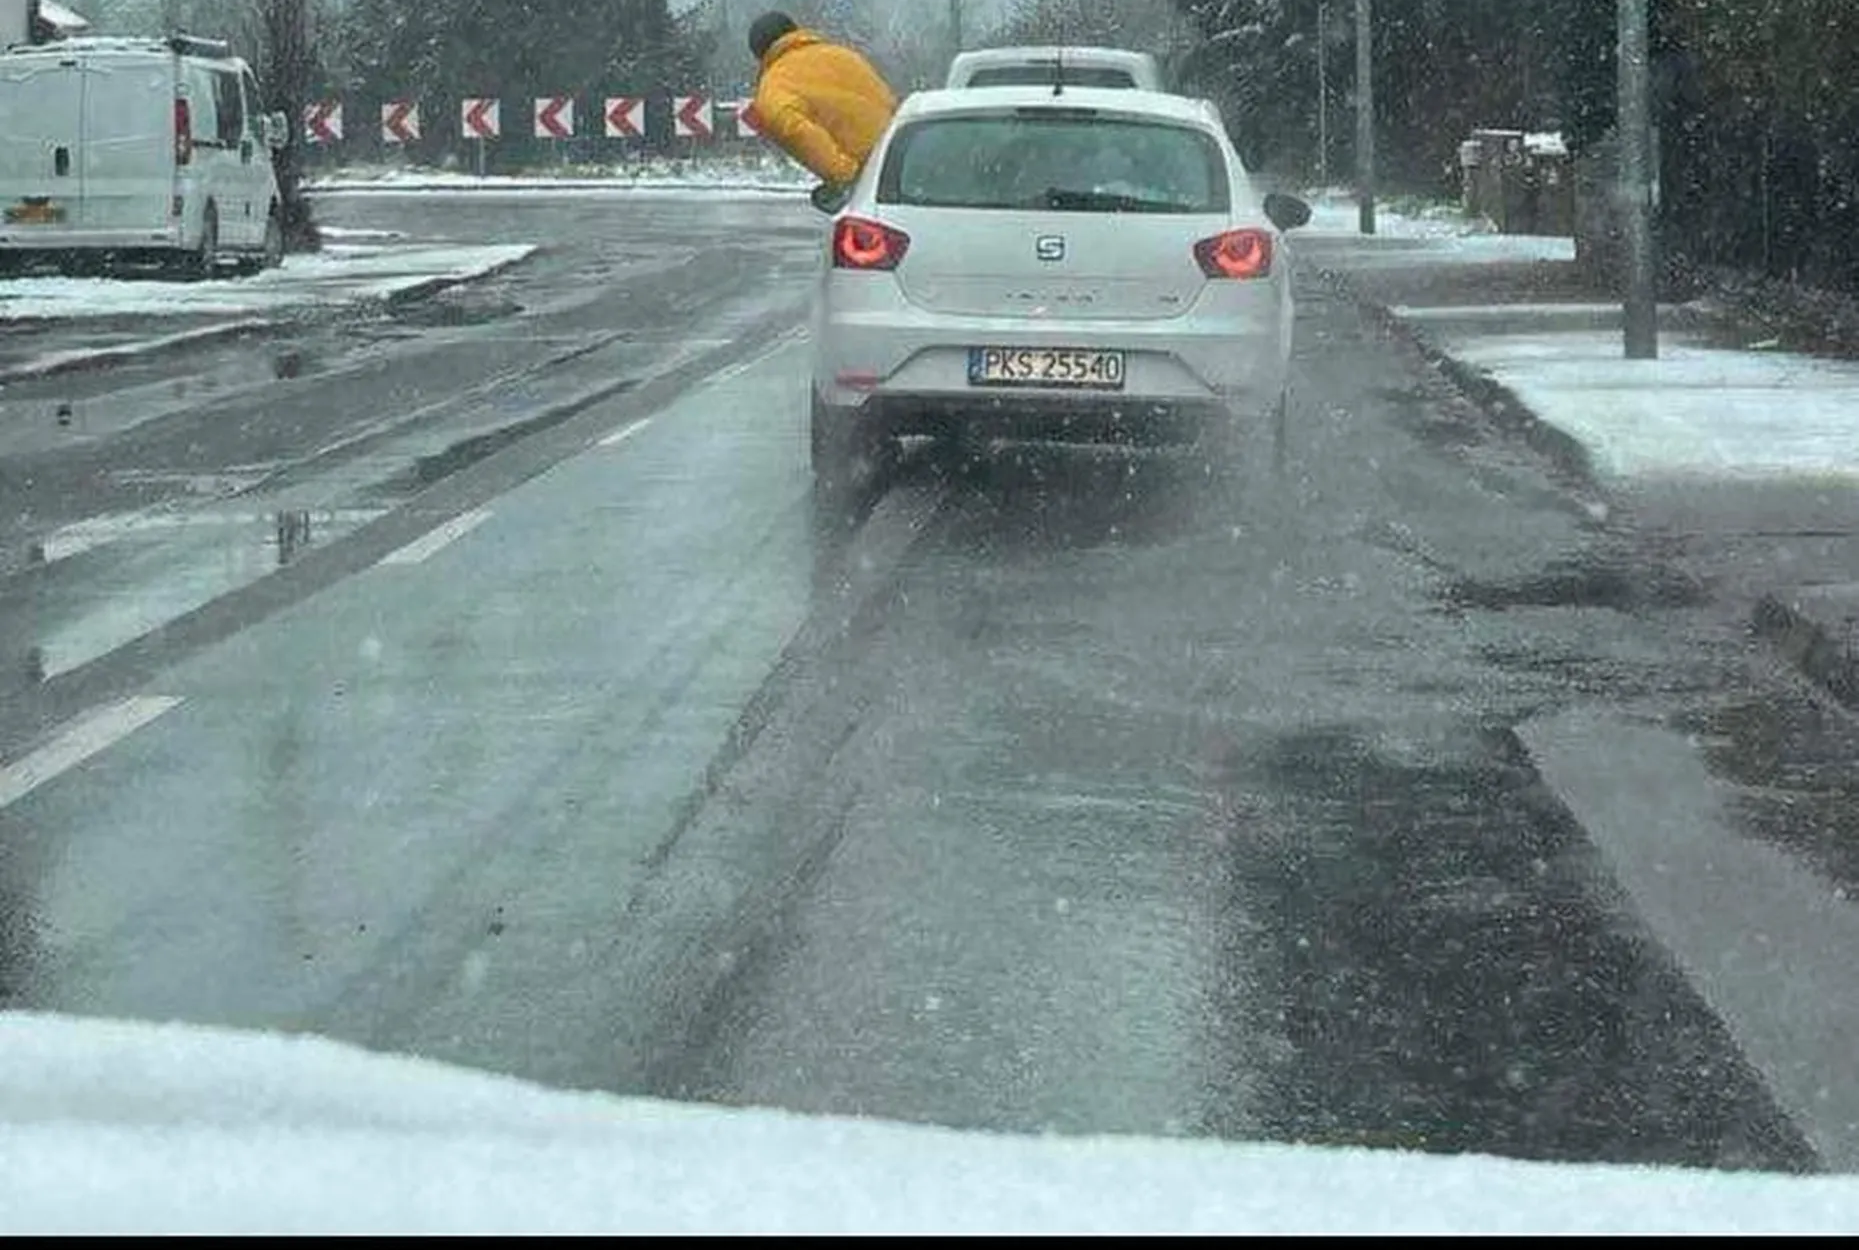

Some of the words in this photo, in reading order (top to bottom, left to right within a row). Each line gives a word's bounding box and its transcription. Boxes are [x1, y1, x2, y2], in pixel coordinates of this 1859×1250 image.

[1036, 235, 1065, 261] S
[985, 350, 1034, 379] PKS
[1042, 352, 1120, 381] 25540
